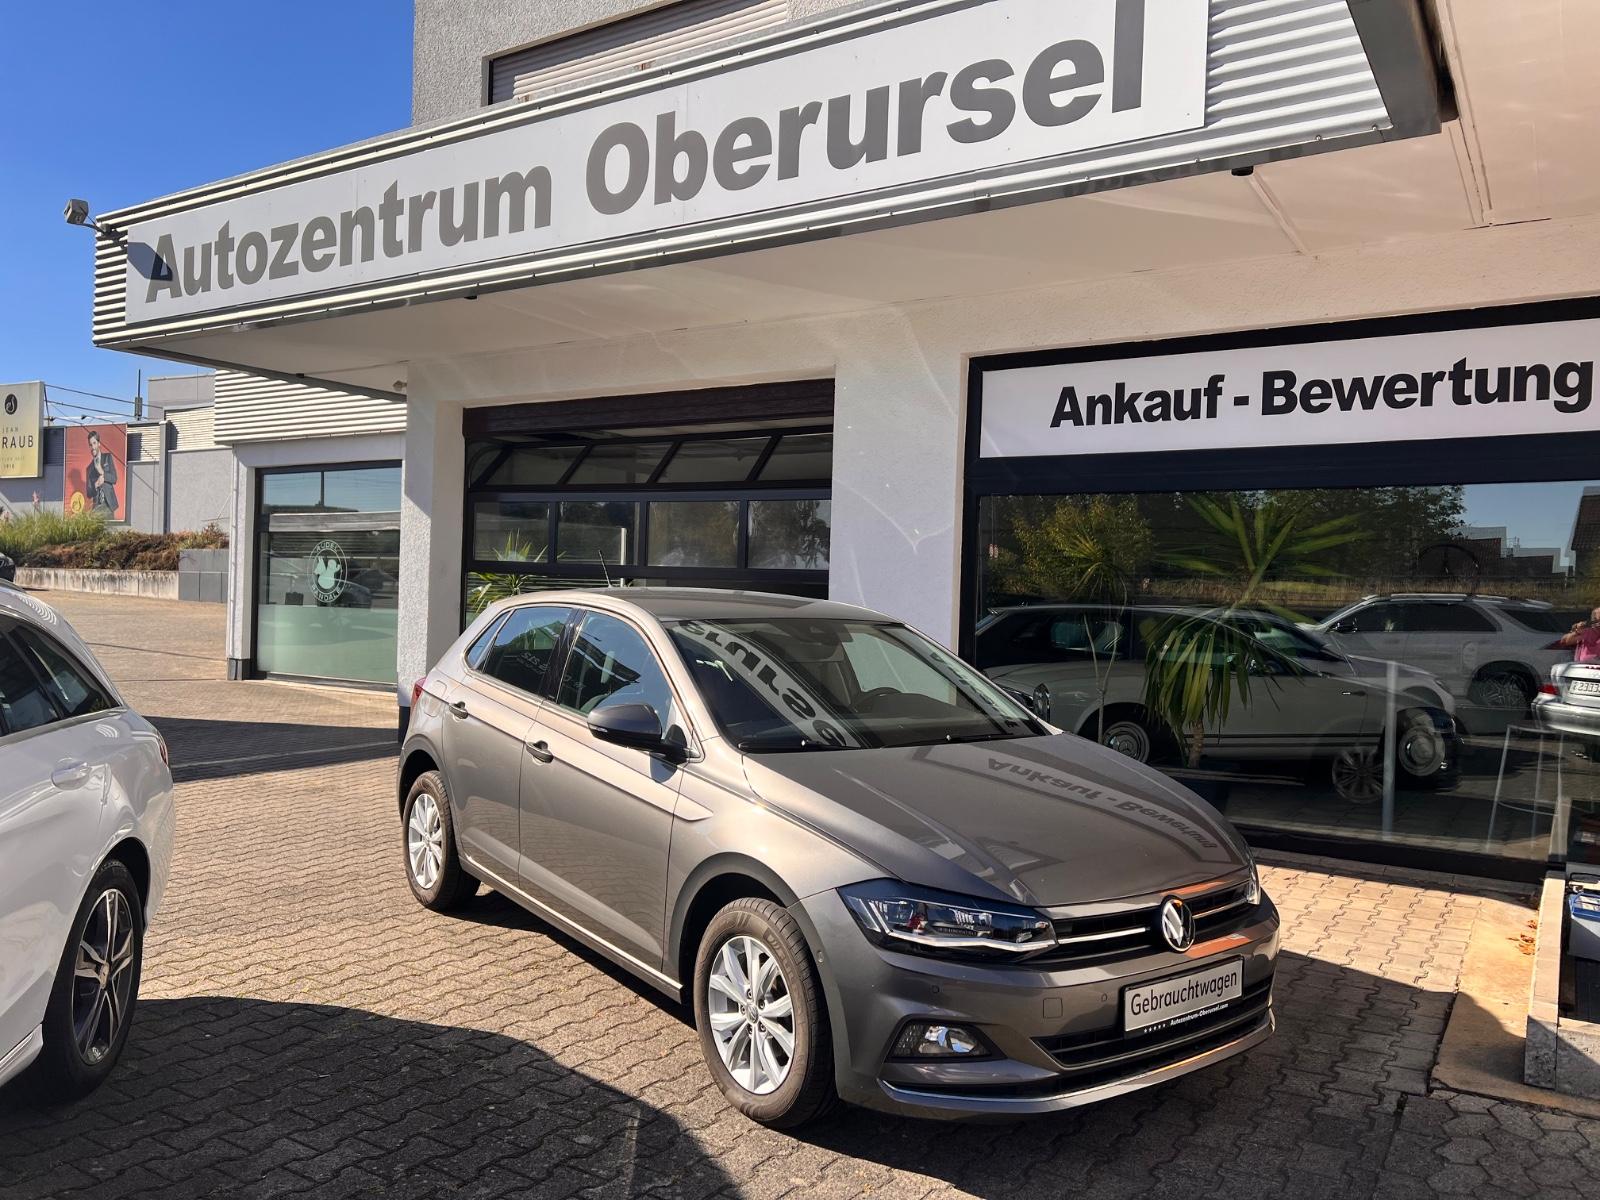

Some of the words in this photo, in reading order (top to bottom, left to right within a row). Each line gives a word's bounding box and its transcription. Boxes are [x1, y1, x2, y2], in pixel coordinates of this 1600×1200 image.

[145, 165, 552, 304] Autozentrum
[586, 0, 1145, 215] Oberursel
[1049, 375, 1224, 428] Ankauf
[1261, 357, 1594, 413] Bewertung
[1130, 971, 1238, 1016] Gebrauchtwagen
